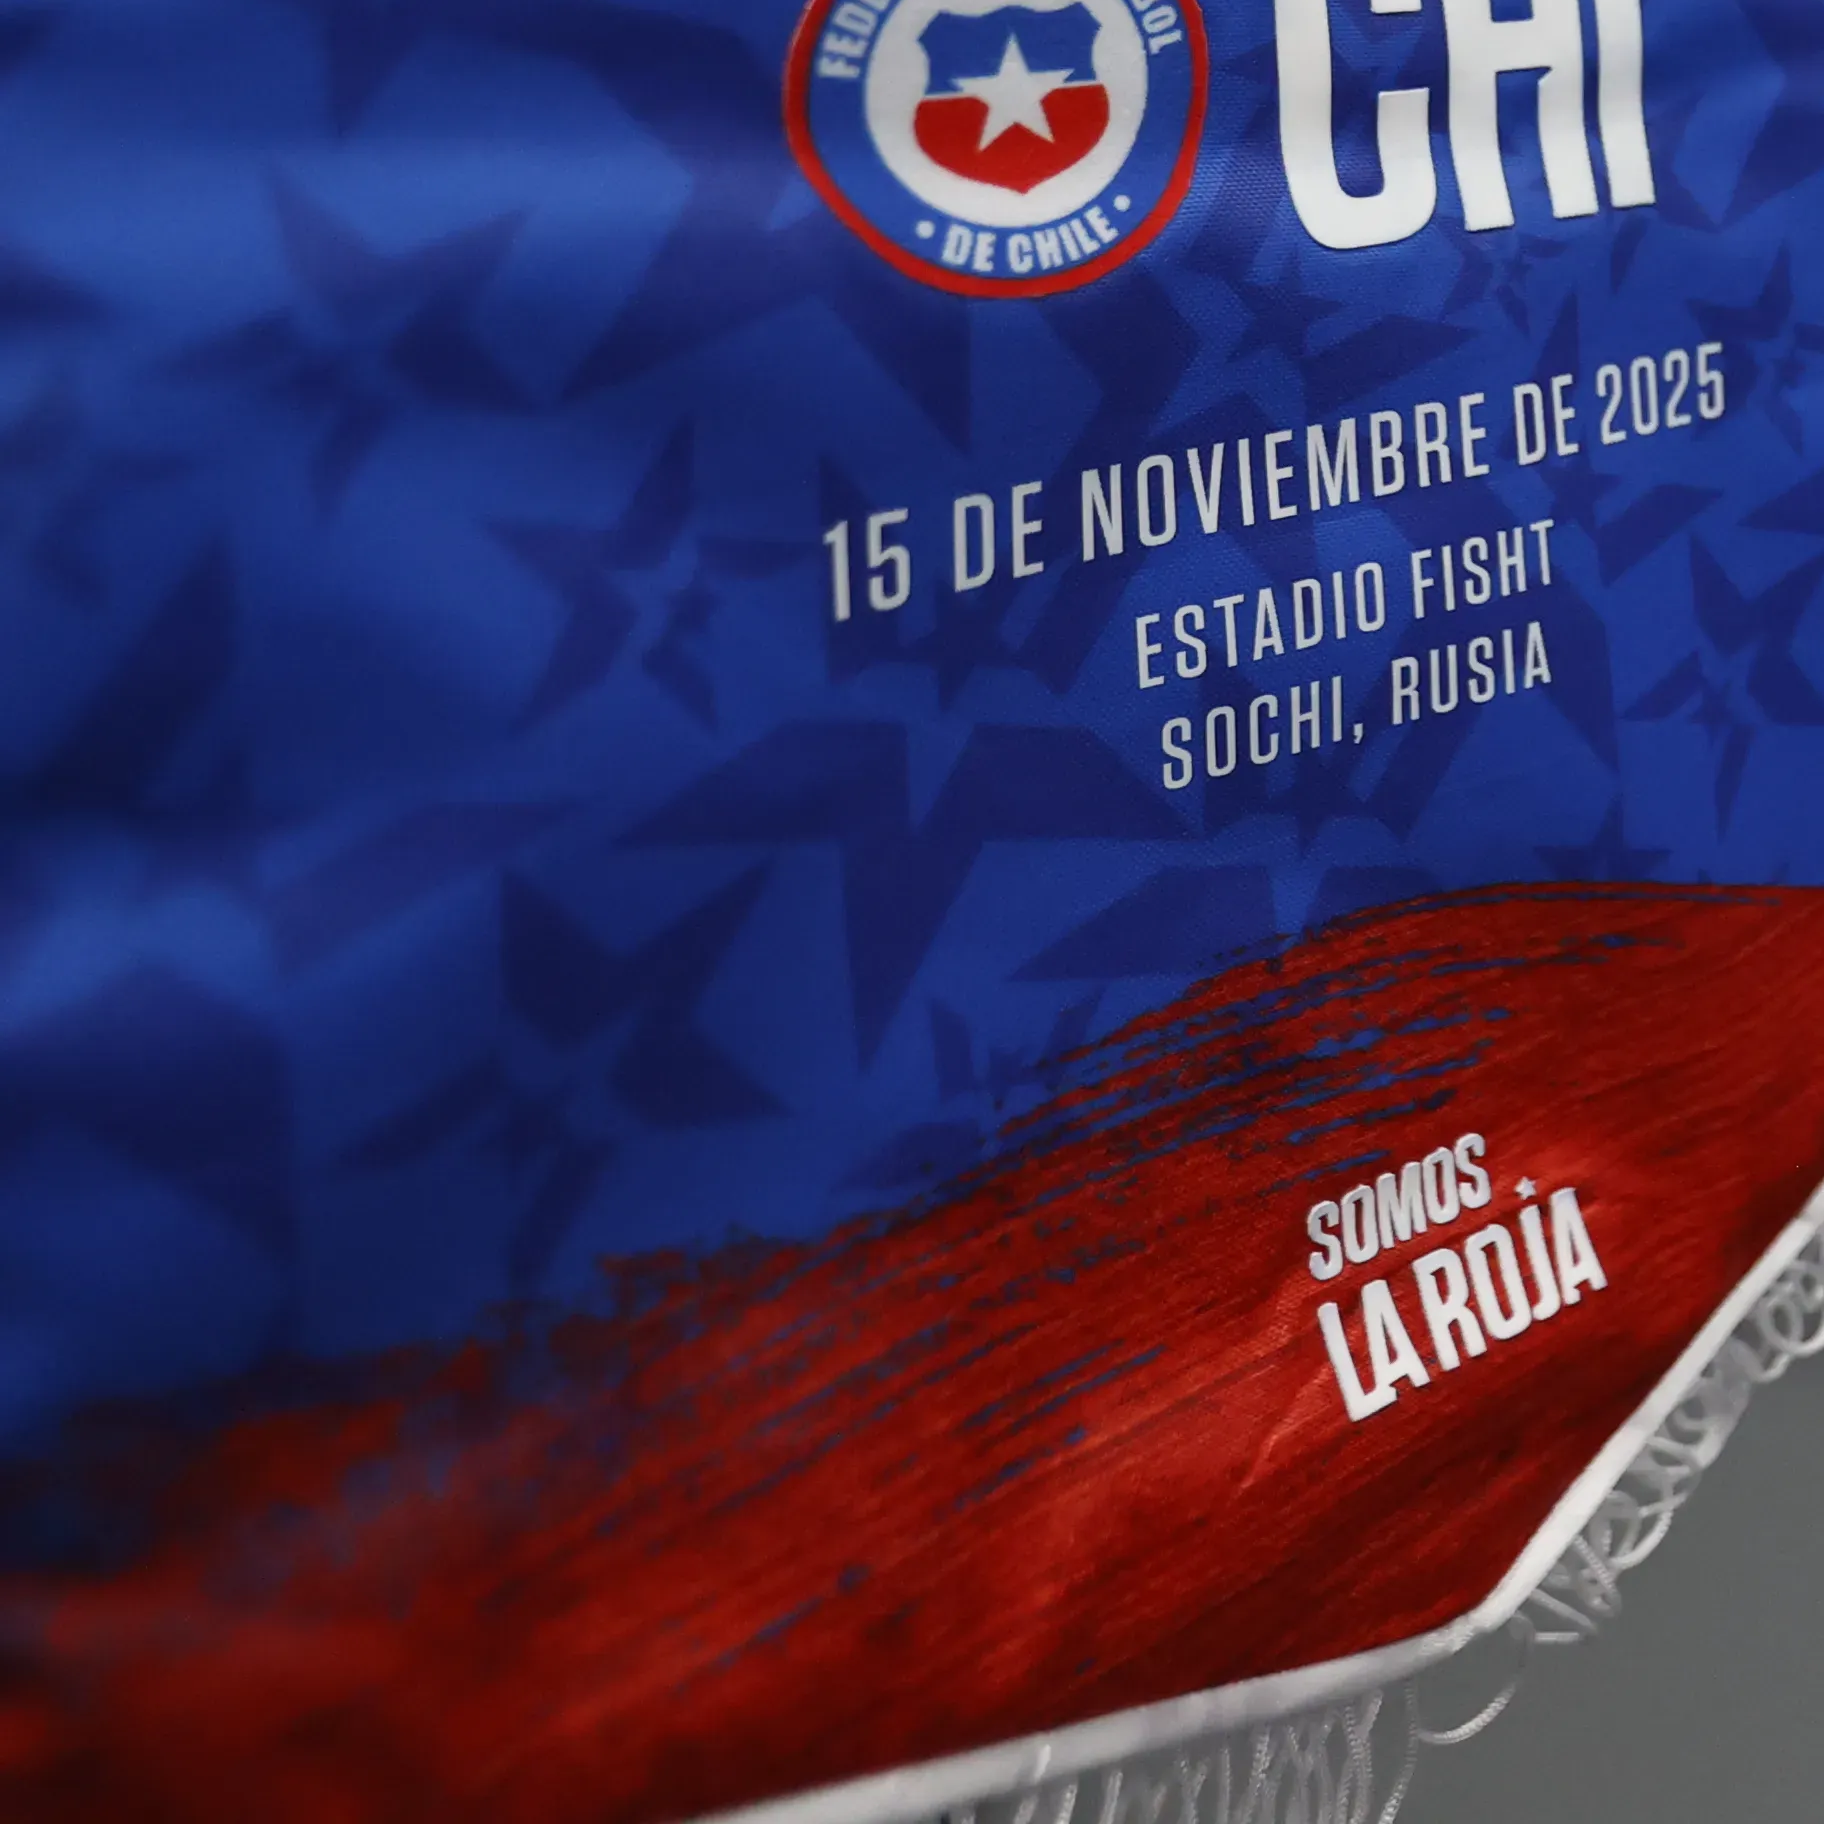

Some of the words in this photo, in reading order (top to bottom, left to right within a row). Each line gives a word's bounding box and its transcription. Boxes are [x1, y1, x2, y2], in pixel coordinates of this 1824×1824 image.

[942, 224, 996, 274] DE
[1007, 204, 1120, 275] CHILE
[823, 507, 911, 623] 15
[952, 480, 1045, 593] DE
[1080, 392, 1490, 562] NOVIEMBRE
[1513, 373, 1579, 466] DE
[1595, 342, 1726, 445] 2025
[1135, 561, 1386, 689] ESTADIO
[1411, 519, 1555, 619] FISHT
[1161, 674, 1365, 790] SOCHI,
[1390, 621, 1552, 726] RUSIA
[1306, 1132, 1492, 1281] SOMOS
[1316, 1278, 1431, 1423] LA
[1411, 1178, 1608, 1372] ROJA
